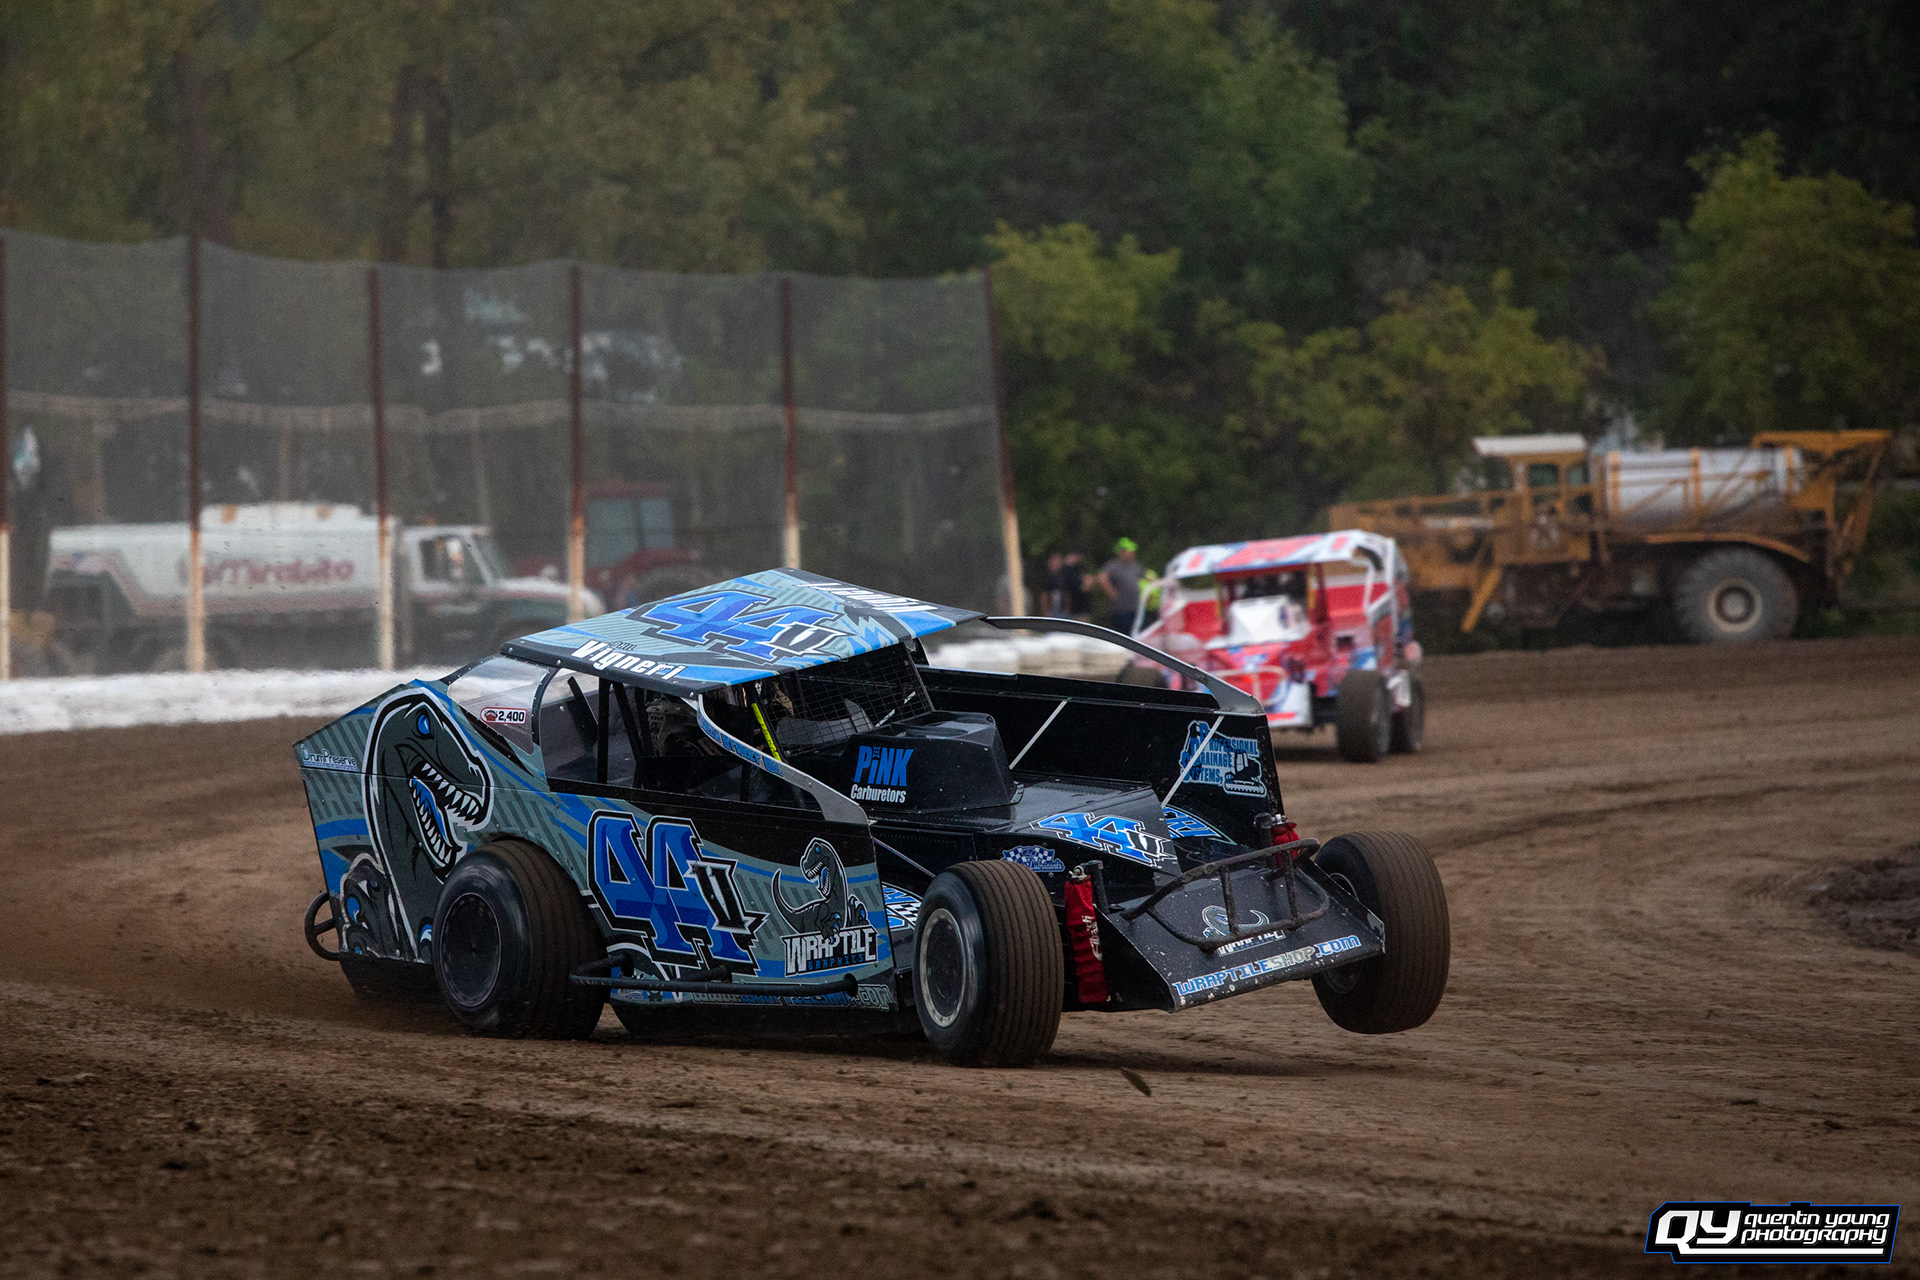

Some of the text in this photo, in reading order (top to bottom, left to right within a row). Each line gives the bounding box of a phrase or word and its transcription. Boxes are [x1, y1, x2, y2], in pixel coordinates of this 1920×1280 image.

[570, 639, 687, 681] Vigneri
[498, 710, 525, 723] 2,400
[850, 784, 907, 803] Carburetors
[784, 928, 876, 975] WRAPTILE
[808, 953, 865, 971] GRAPHICS
